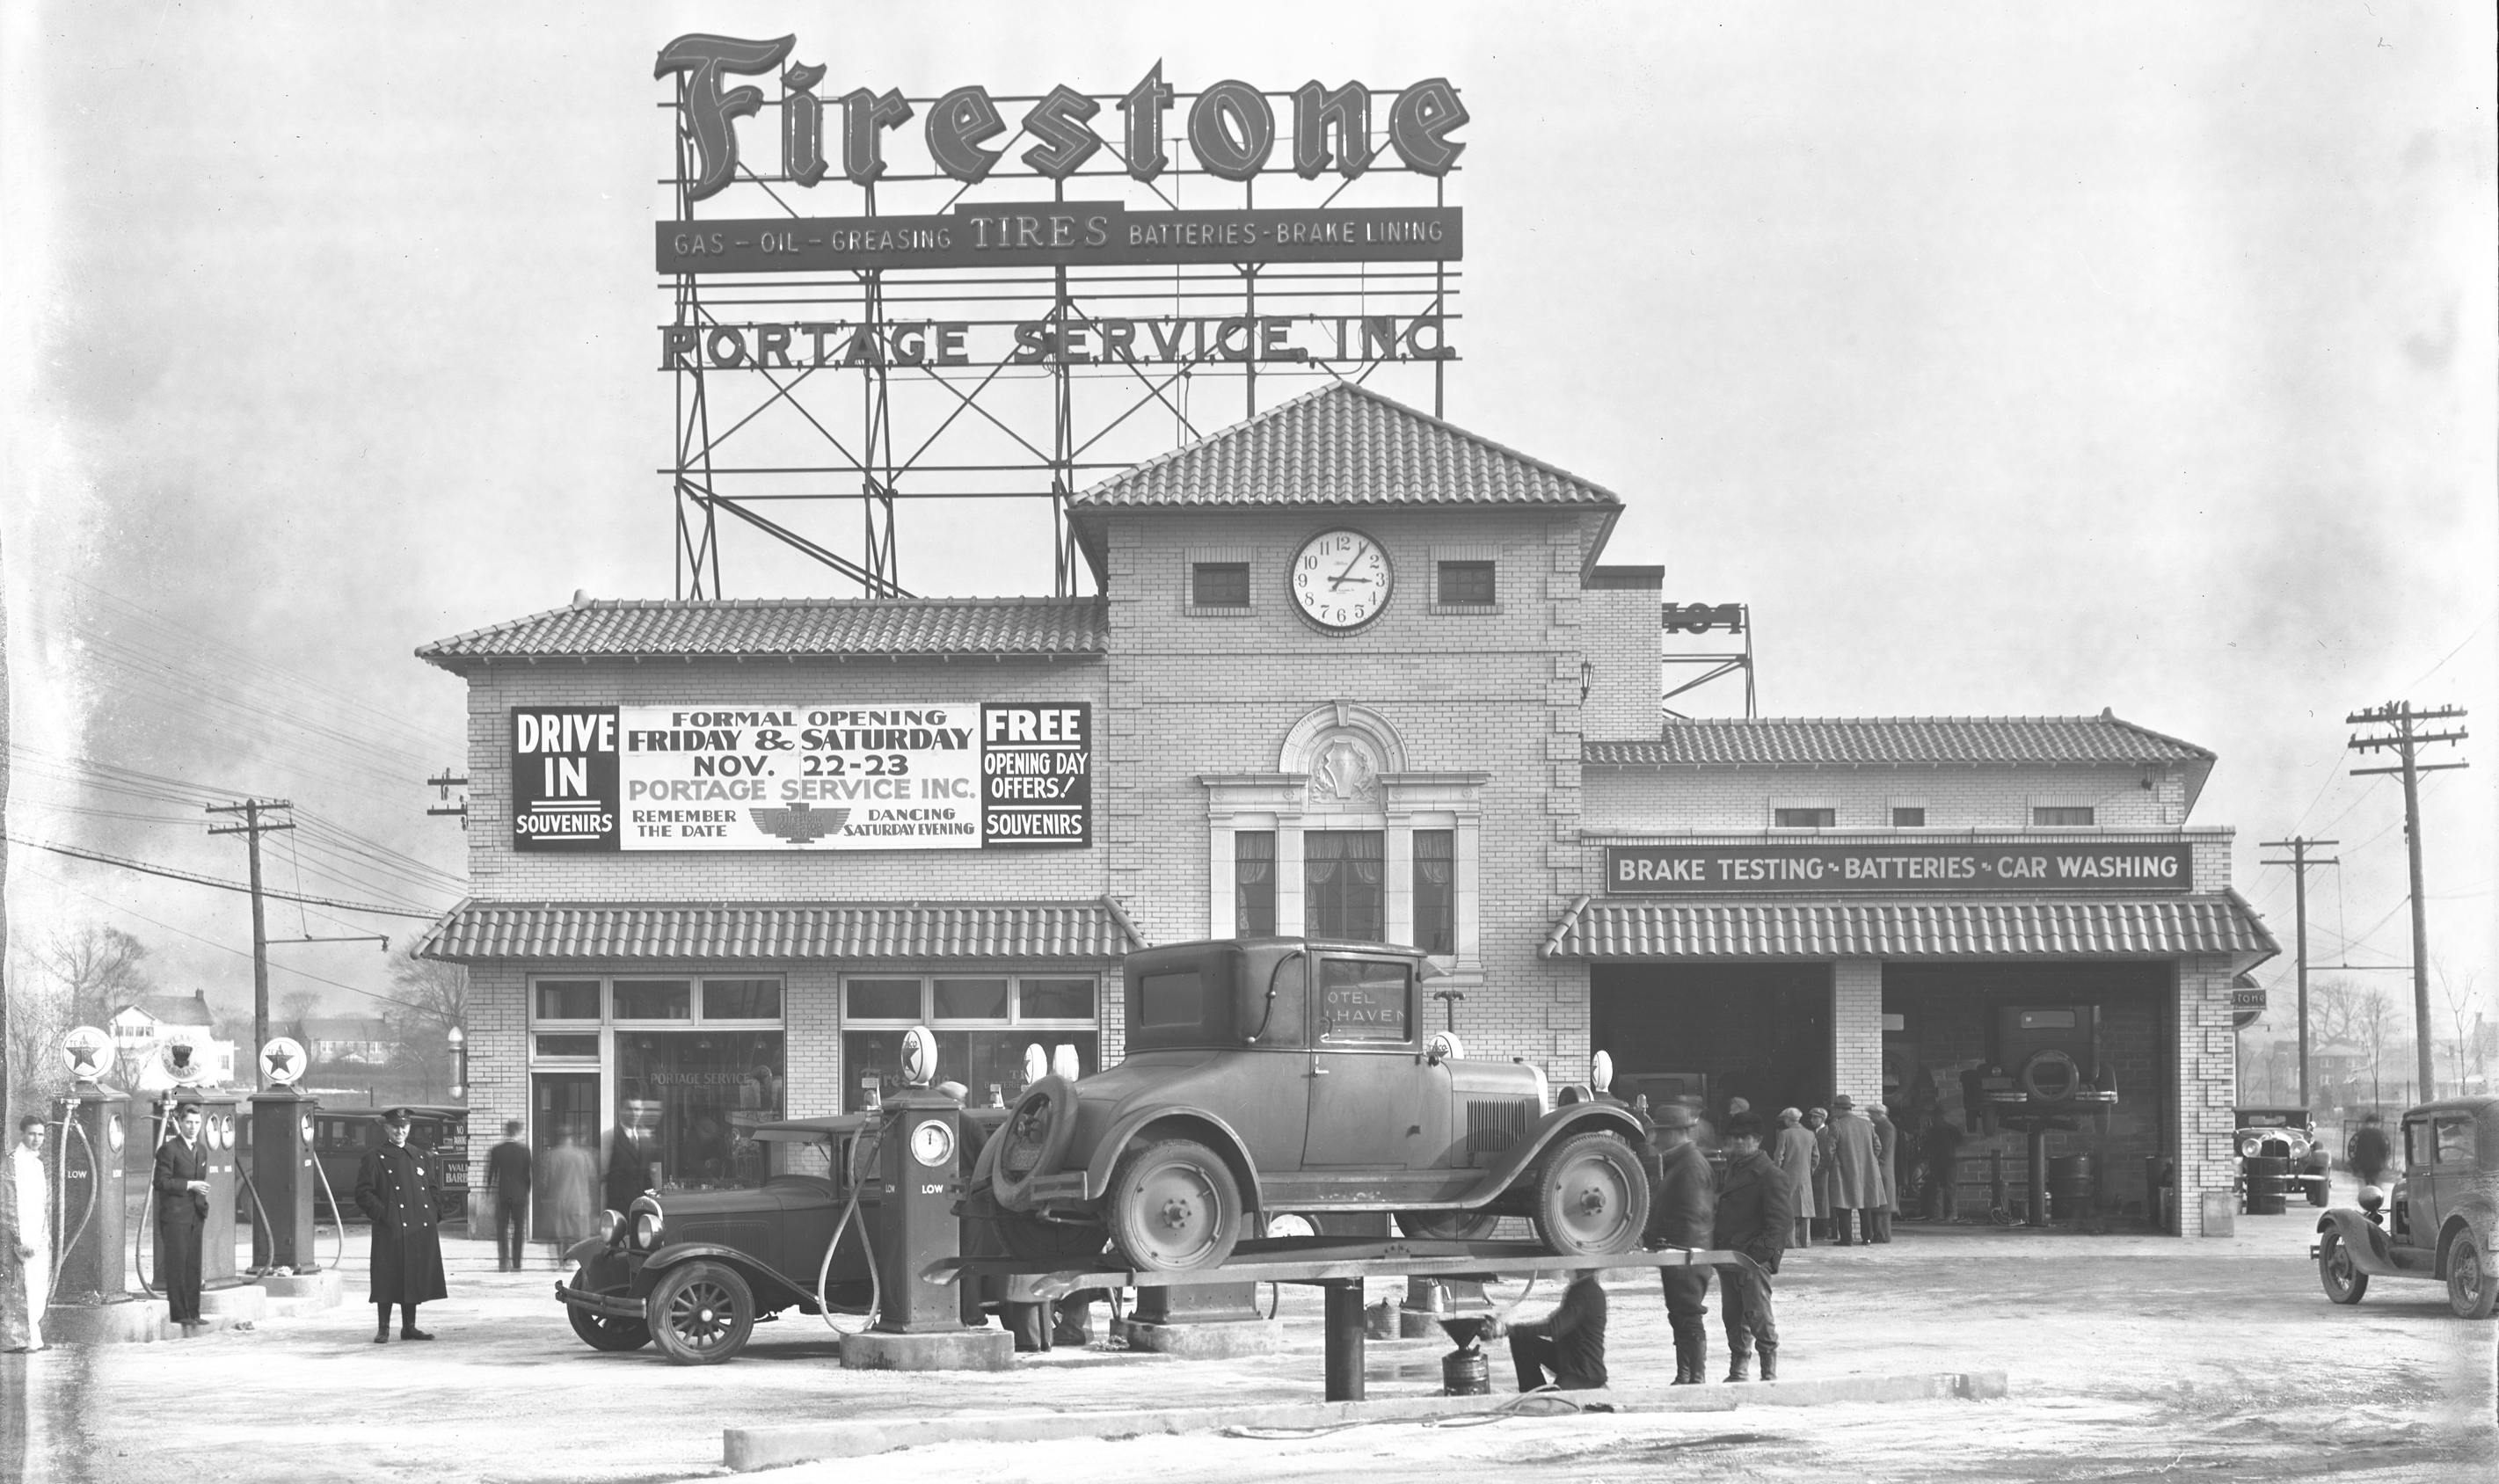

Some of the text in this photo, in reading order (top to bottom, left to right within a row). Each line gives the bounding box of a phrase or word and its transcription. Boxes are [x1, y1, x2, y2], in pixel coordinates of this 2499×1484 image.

[654, 33, 1470, 201] Firestone
[674, 233, 724, 255] GAS
[761, 232, 799, 253] OIL
[832, 228, 952, 252] GREASING
[970, 215, 1108, 250] TIRES
[1366, 220, 1444, 243] LINING
[661, 322, 969, 369] PORTAGE
[1320, 541, 1330, 556] 11
[1337, 536, 1351, 551] 12
[1304, 556, 1317, 570] 10
[1370, 555, 1380, 569] 2
[1298, 573, 1308, 587] 9
[1376, 572, 1385, 587] 3
[1305, 592, 1314, 606] 8
[1368, 591, 1376, 606] 4
[1321, 605, 1330, 619] 7
[1337, 608, 1346, 622] 6
[1355, 604, 1365, 619] 5
[672, 710, 947, 727] FORMAL OPENING
[986, 709, 1081, 741] FREE
[518, 714, 615, 753] DRIVE
[628, 728, 973, 752] FRIDAY & SATURDAY
[694, 754, 909, 776] NOV. 22-23
[984, 753, 1089, 775] OPENING DAY
[544, 757, 587, 797] IN
[629, 778, 976, 801] PORTAGE SERVICE INC.
[991, 776, 1075, 799] OFFERS!
[632, 810, 737, 823] REMEMBER
[868, 808, 956, 821] DANCING
[516, 813, 613, 833] SOUVENIRS
[844, 823, 975, 837] SATURDAY EVENING
[986, 813, 1082, 836] SOUVENIRS
[638, 825, 727, 837] THE DATE
[1619, 855, 2179, 880] BRAKE TESTING BATTERIES CAR WASHING
[651, 1073, 750, 1085] PORTAGE SERVICE
[68, 1170, 87, 1179] LOW
[885, 1183, 895, 1193] LOW
[922, 1184, 944, 1194] LOW
